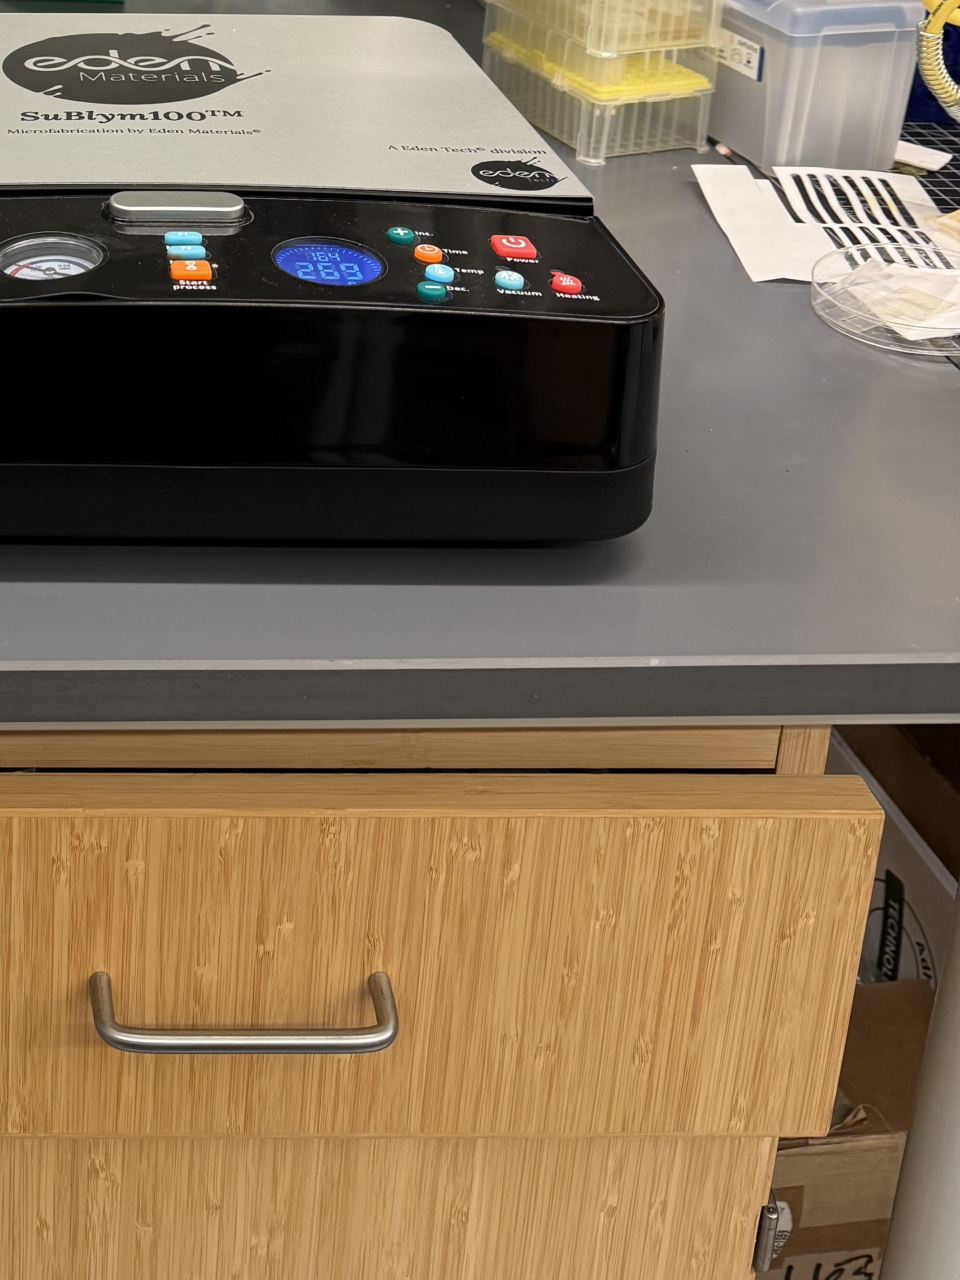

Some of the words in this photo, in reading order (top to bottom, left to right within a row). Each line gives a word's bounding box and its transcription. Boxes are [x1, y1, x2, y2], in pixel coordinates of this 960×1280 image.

[80, 72, 225, 83] Materials
[296, 262, 363, 280] 269
[497, 289, 542, 297] Vacuum
[556, 293, 600, 301] Heating
